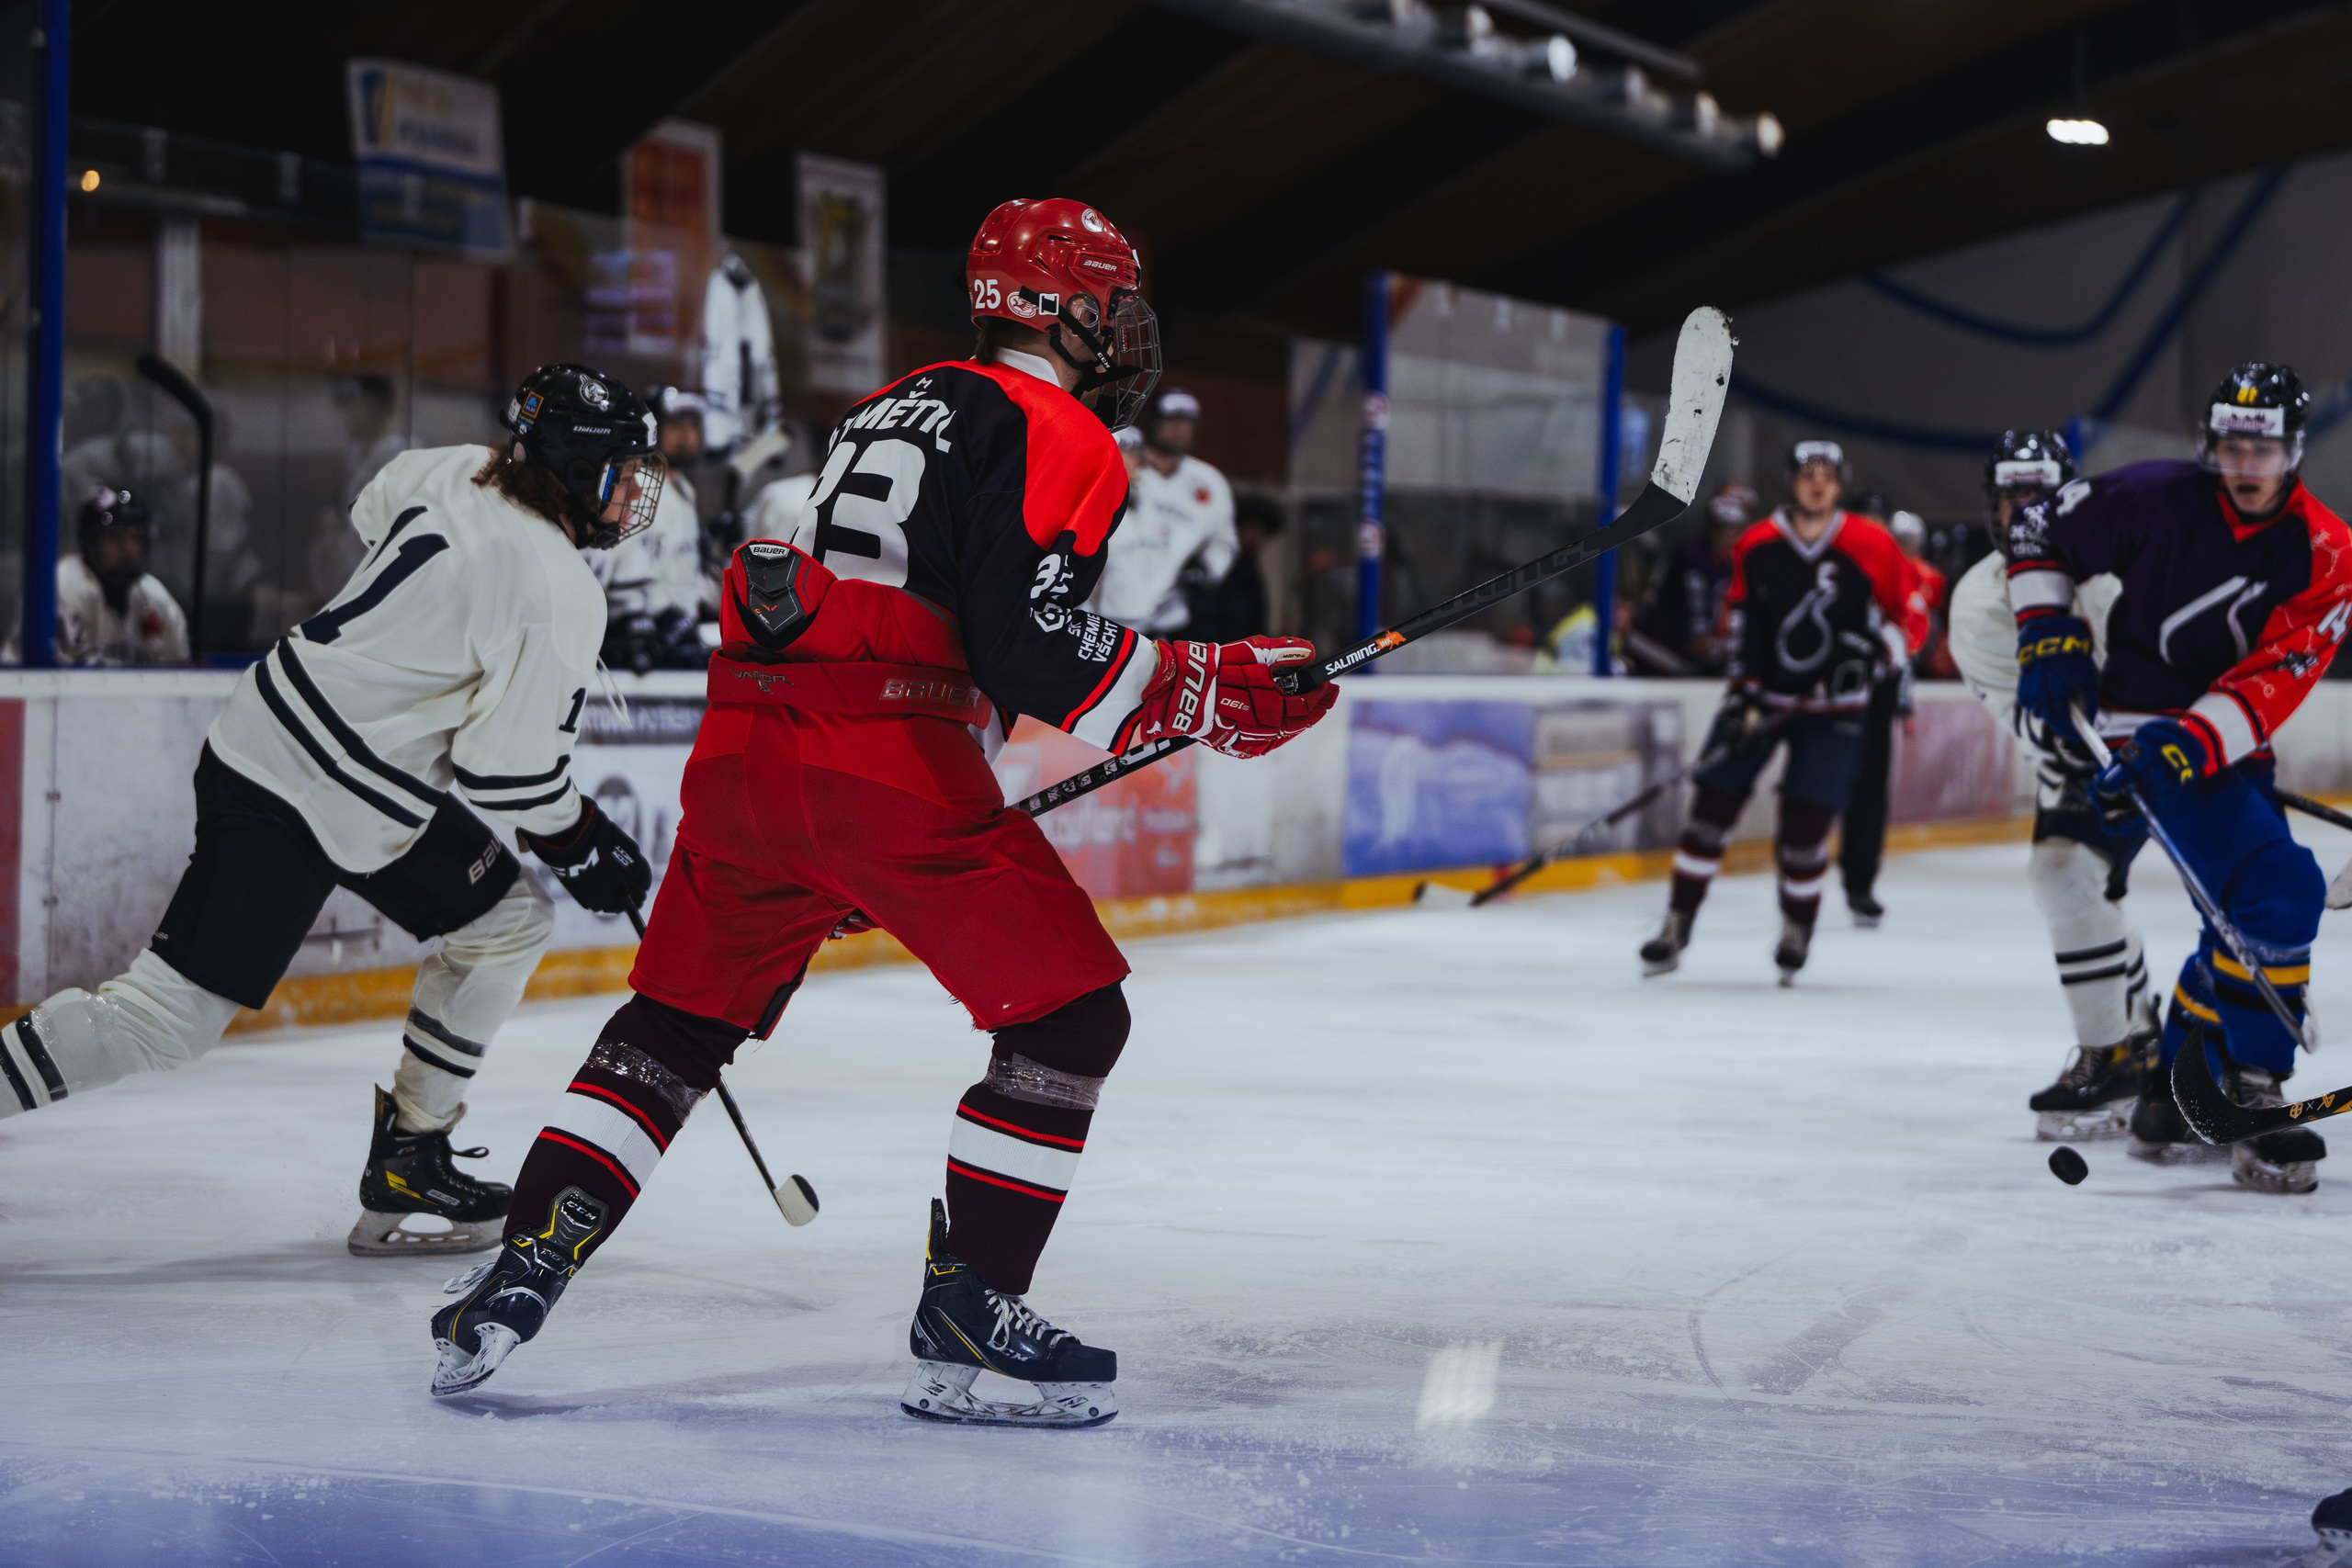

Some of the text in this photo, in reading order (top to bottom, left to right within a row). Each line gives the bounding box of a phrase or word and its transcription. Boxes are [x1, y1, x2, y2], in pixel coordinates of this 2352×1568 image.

[1083, 259, 1117, 272] BAUER
[975, 278, 1001, 310] 25
[1097, 352, 1111, 368] CCM
[753, 547, 786, 555] BAUER
[1068, 621, 1082, 637] SK
[1078, 613, 1101, 660] CHEMIE
[1092, 621, 1118, 662] VŠCHT
[883, 679, 982, 708] BAUER
[1171, 640, 1208, 732] BAUE
[567, 1201, 597, 1221] CCM
